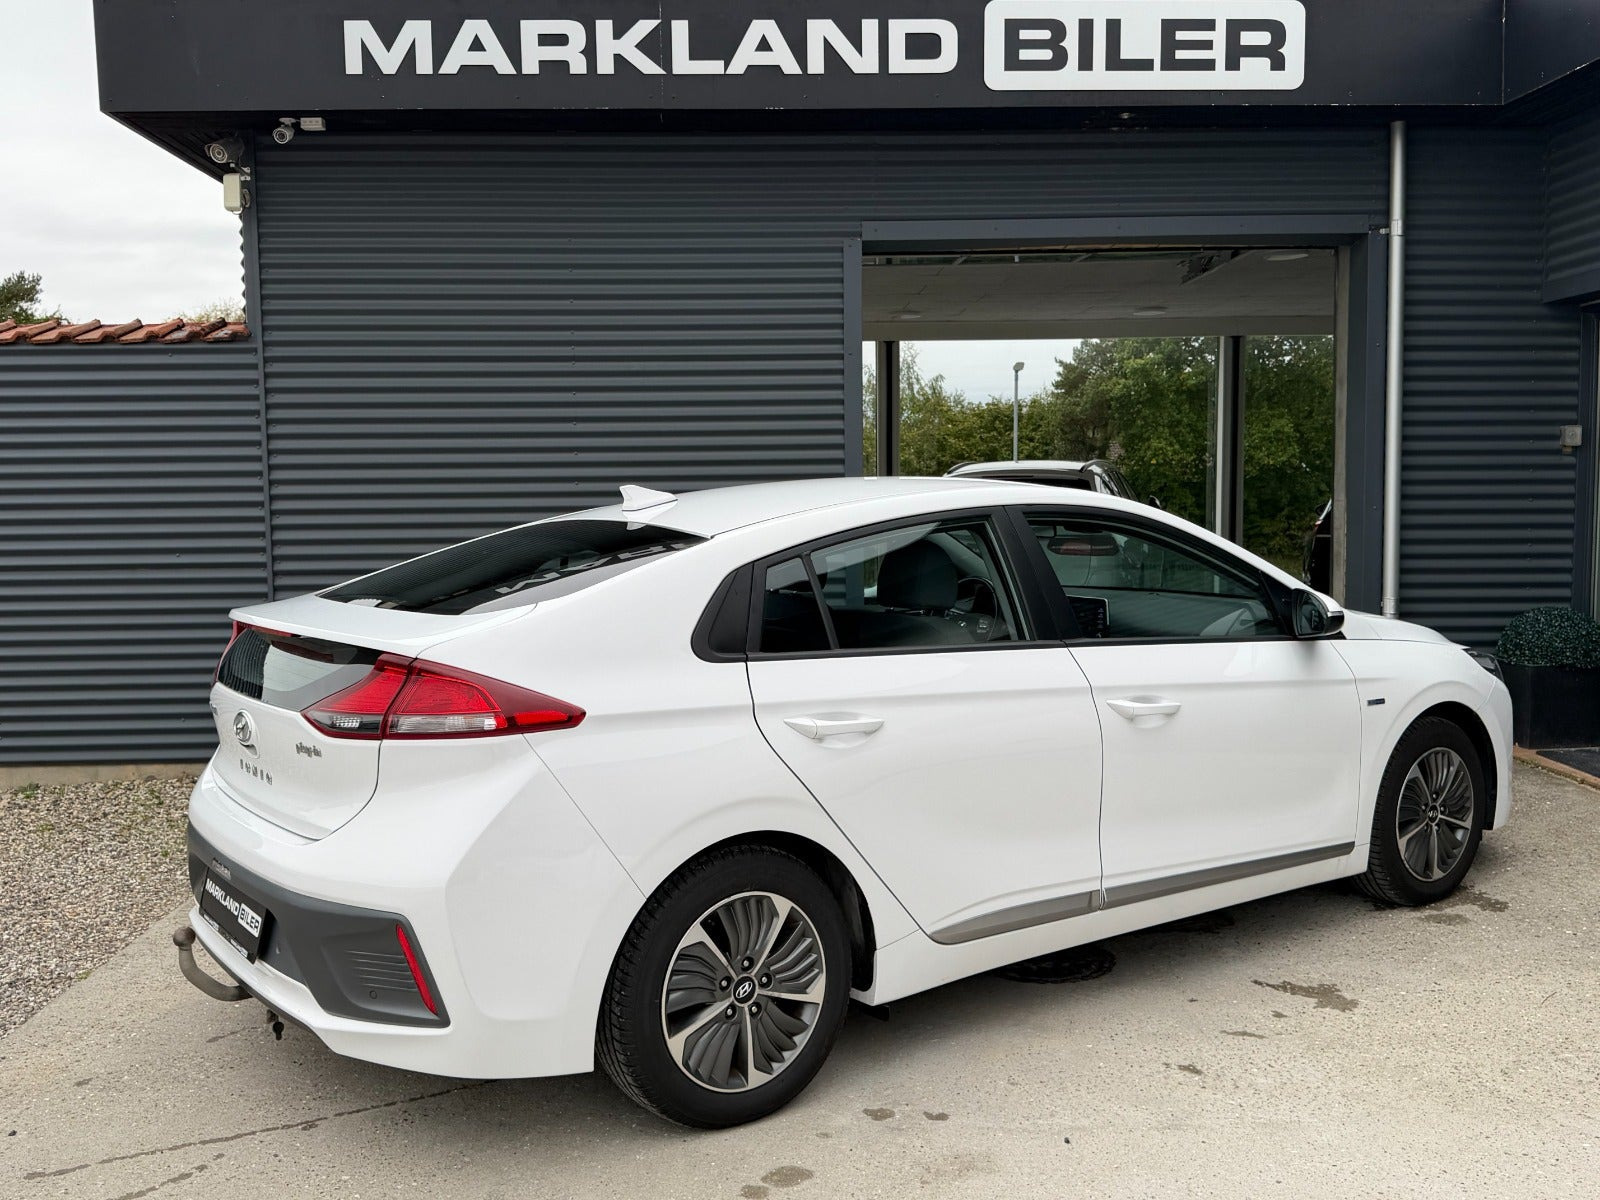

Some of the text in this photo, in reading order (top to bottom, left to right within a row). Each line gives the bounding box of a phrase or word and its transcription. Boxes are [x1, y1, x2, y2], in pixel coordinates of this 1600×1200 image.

[343, 18, 1287, 75] MARKLAND BILER
[205, 878, 240, 916] MARKLAND
[240, 908, 260, 933] BILER
